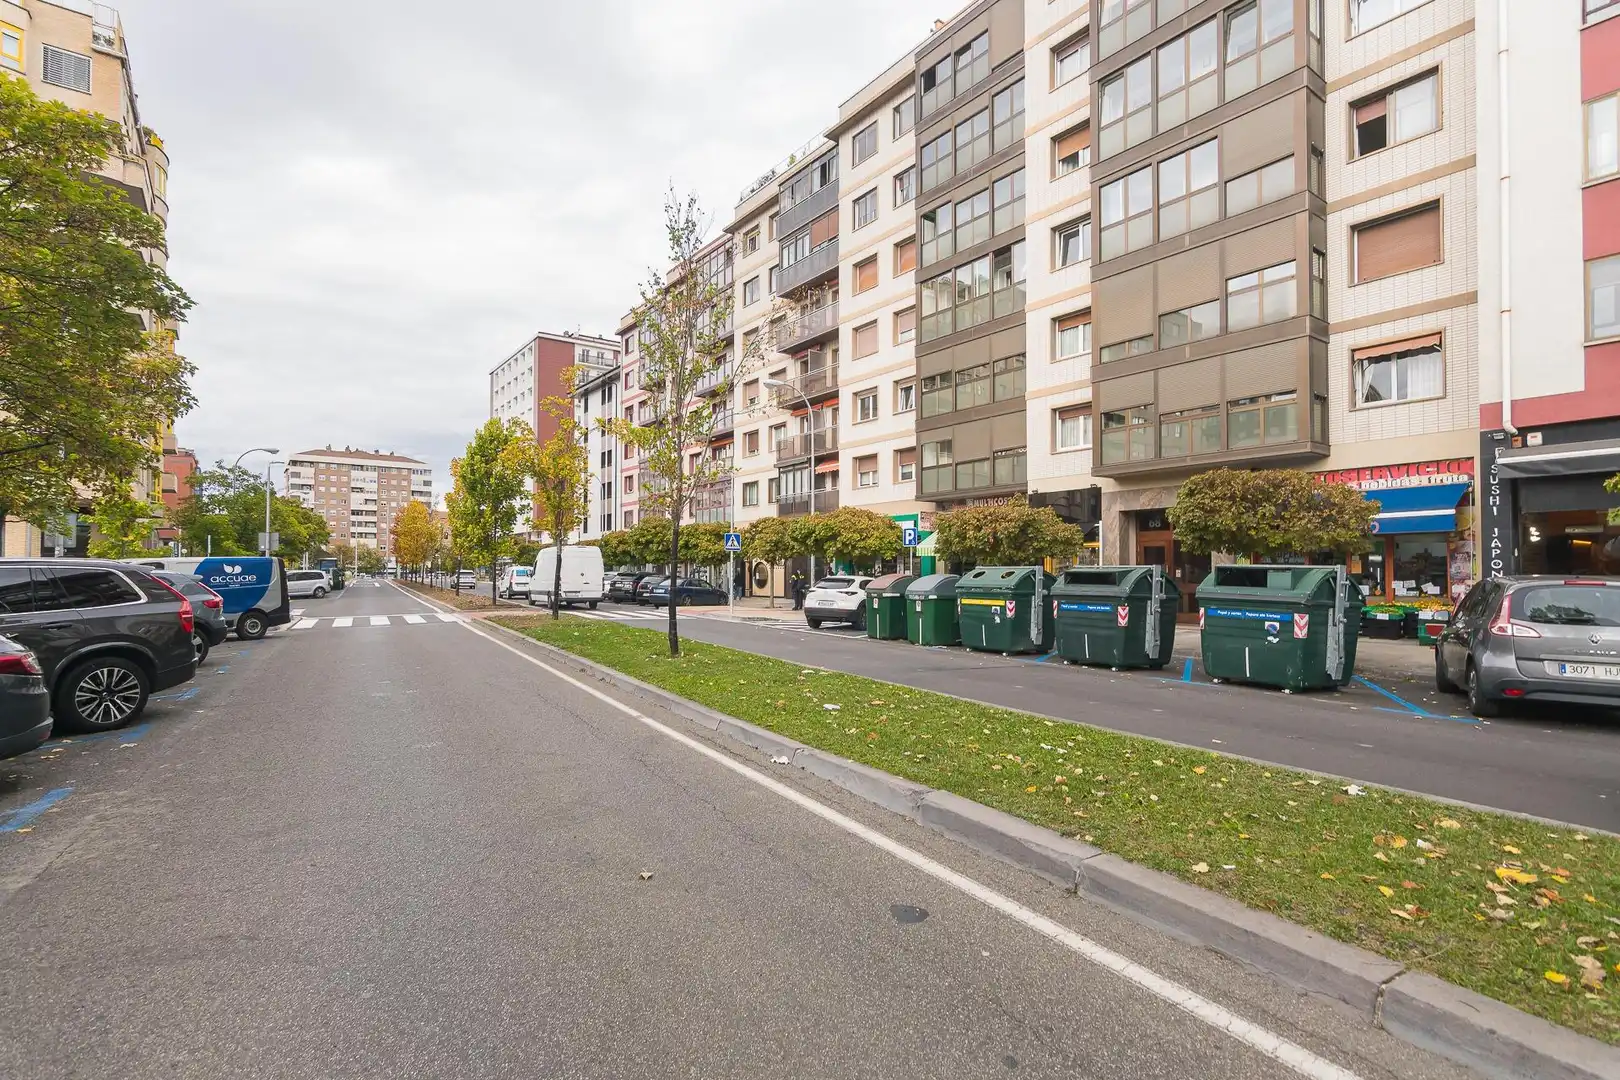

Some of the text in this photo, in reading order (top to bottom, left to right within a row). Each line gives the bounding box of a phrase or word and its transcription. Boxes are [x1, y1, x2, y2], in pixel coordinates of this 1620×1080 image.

[1489, 464, 1500, 516] SUSHI
[905, 529, 915, 545] P
[210, 575, 256, 583] accuae
[1569, 665, 1620, 677] 3071 HJ
